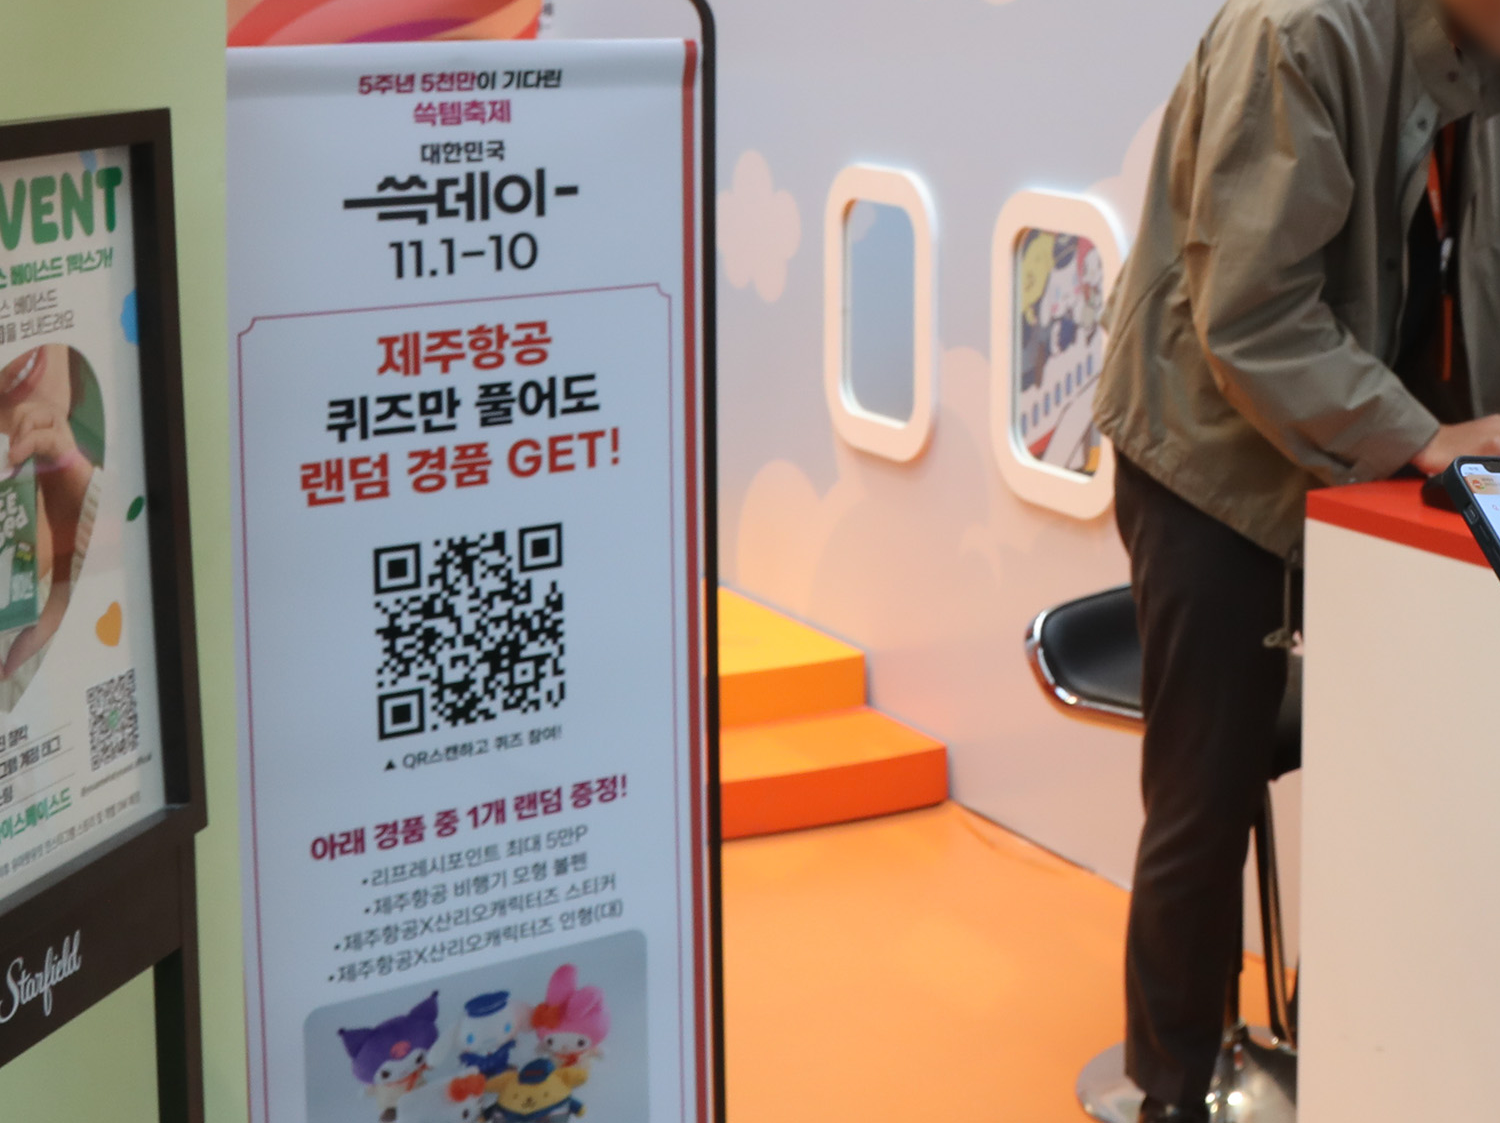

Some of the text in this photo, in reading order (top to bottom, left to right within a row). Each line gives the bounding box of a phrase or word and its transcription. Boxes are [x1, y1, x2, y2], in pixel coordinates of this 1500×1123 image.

[358, 69, 563, 95] 5주년 5천만이 기다린
[413, 99, 511, 127] 쓱템축제
[420, 140, 505, 164] 대한민국
[376, 321, 552, 376] 제주항공
[326, 373, 601, 442] 퀴즈만 풀어도
[300, 426, 621, 508] 랜덤 경품 GET!
[494, 731, 524, 751] 퀴즈
[310, 774, 628, 862] 아래 경품 중 1개 랜덤 증정!
[369, 843, 502, 887] 리프레시포인트
[506, 835, 542, 857] 최대
[373, 851, 590, 917] 제주항공 비행기 모형 볼펜
[564, 873, 618, 901] 스티커
